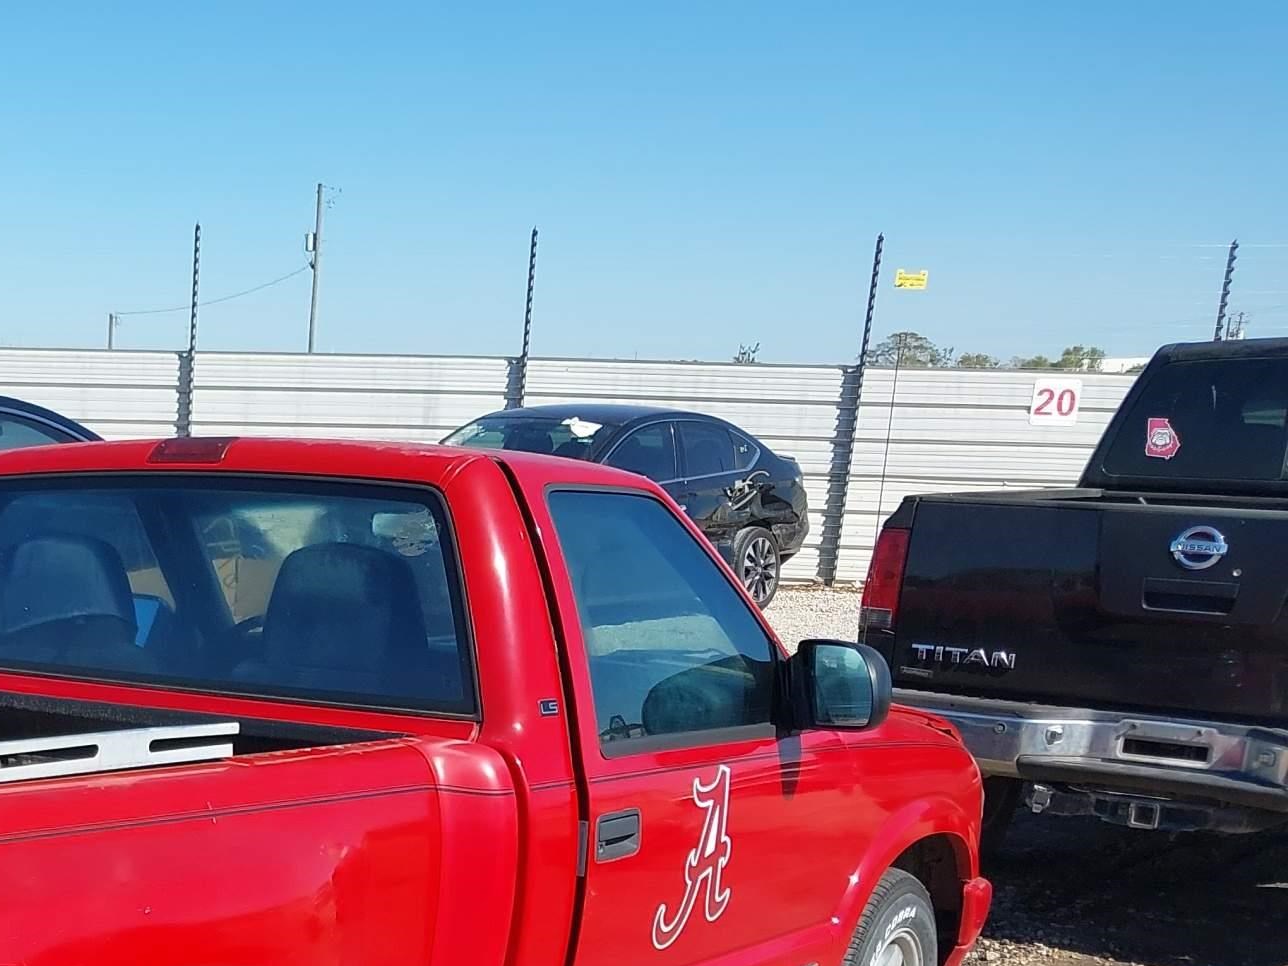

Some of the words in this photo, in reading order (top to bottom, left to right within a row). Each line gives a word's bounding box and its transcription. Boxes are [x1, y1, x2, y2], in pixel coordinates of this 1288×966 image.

[1034, 388, 1076, 416] 20
[1176, 543, 1222, 553] NISSAN
[911, 643, 1016, 669] TITAN
[541, 702, 558, 715] LS
[652, 765, 732, 949] A
[884, 905, 917, 940] COBRA
